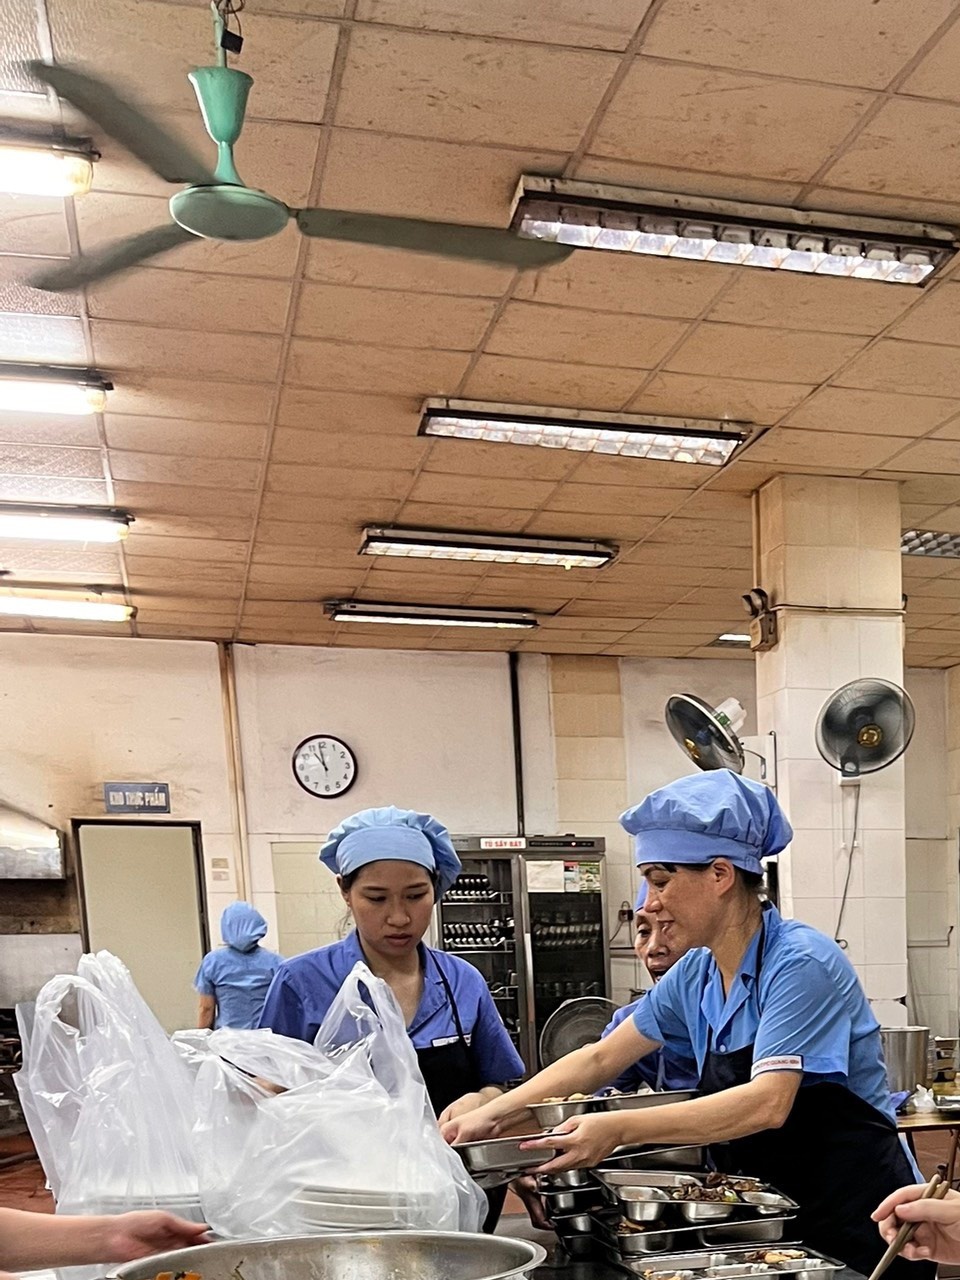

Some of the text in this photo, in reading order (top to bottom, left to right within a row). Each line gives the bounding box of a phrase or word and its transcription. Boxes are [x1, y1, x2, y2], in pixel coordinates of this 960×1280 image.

[301, 753, 310, 761] 10
[340, 751, 346, 759] 2
[298, 763, 305, 771] 9
[344, 762, 350, 770] 3
[304, 775, 310, 783] 8
[343, 773, 349, 781] 4
[324, 784, 331, 792] 6
[335, 781, 341, 789] 5
